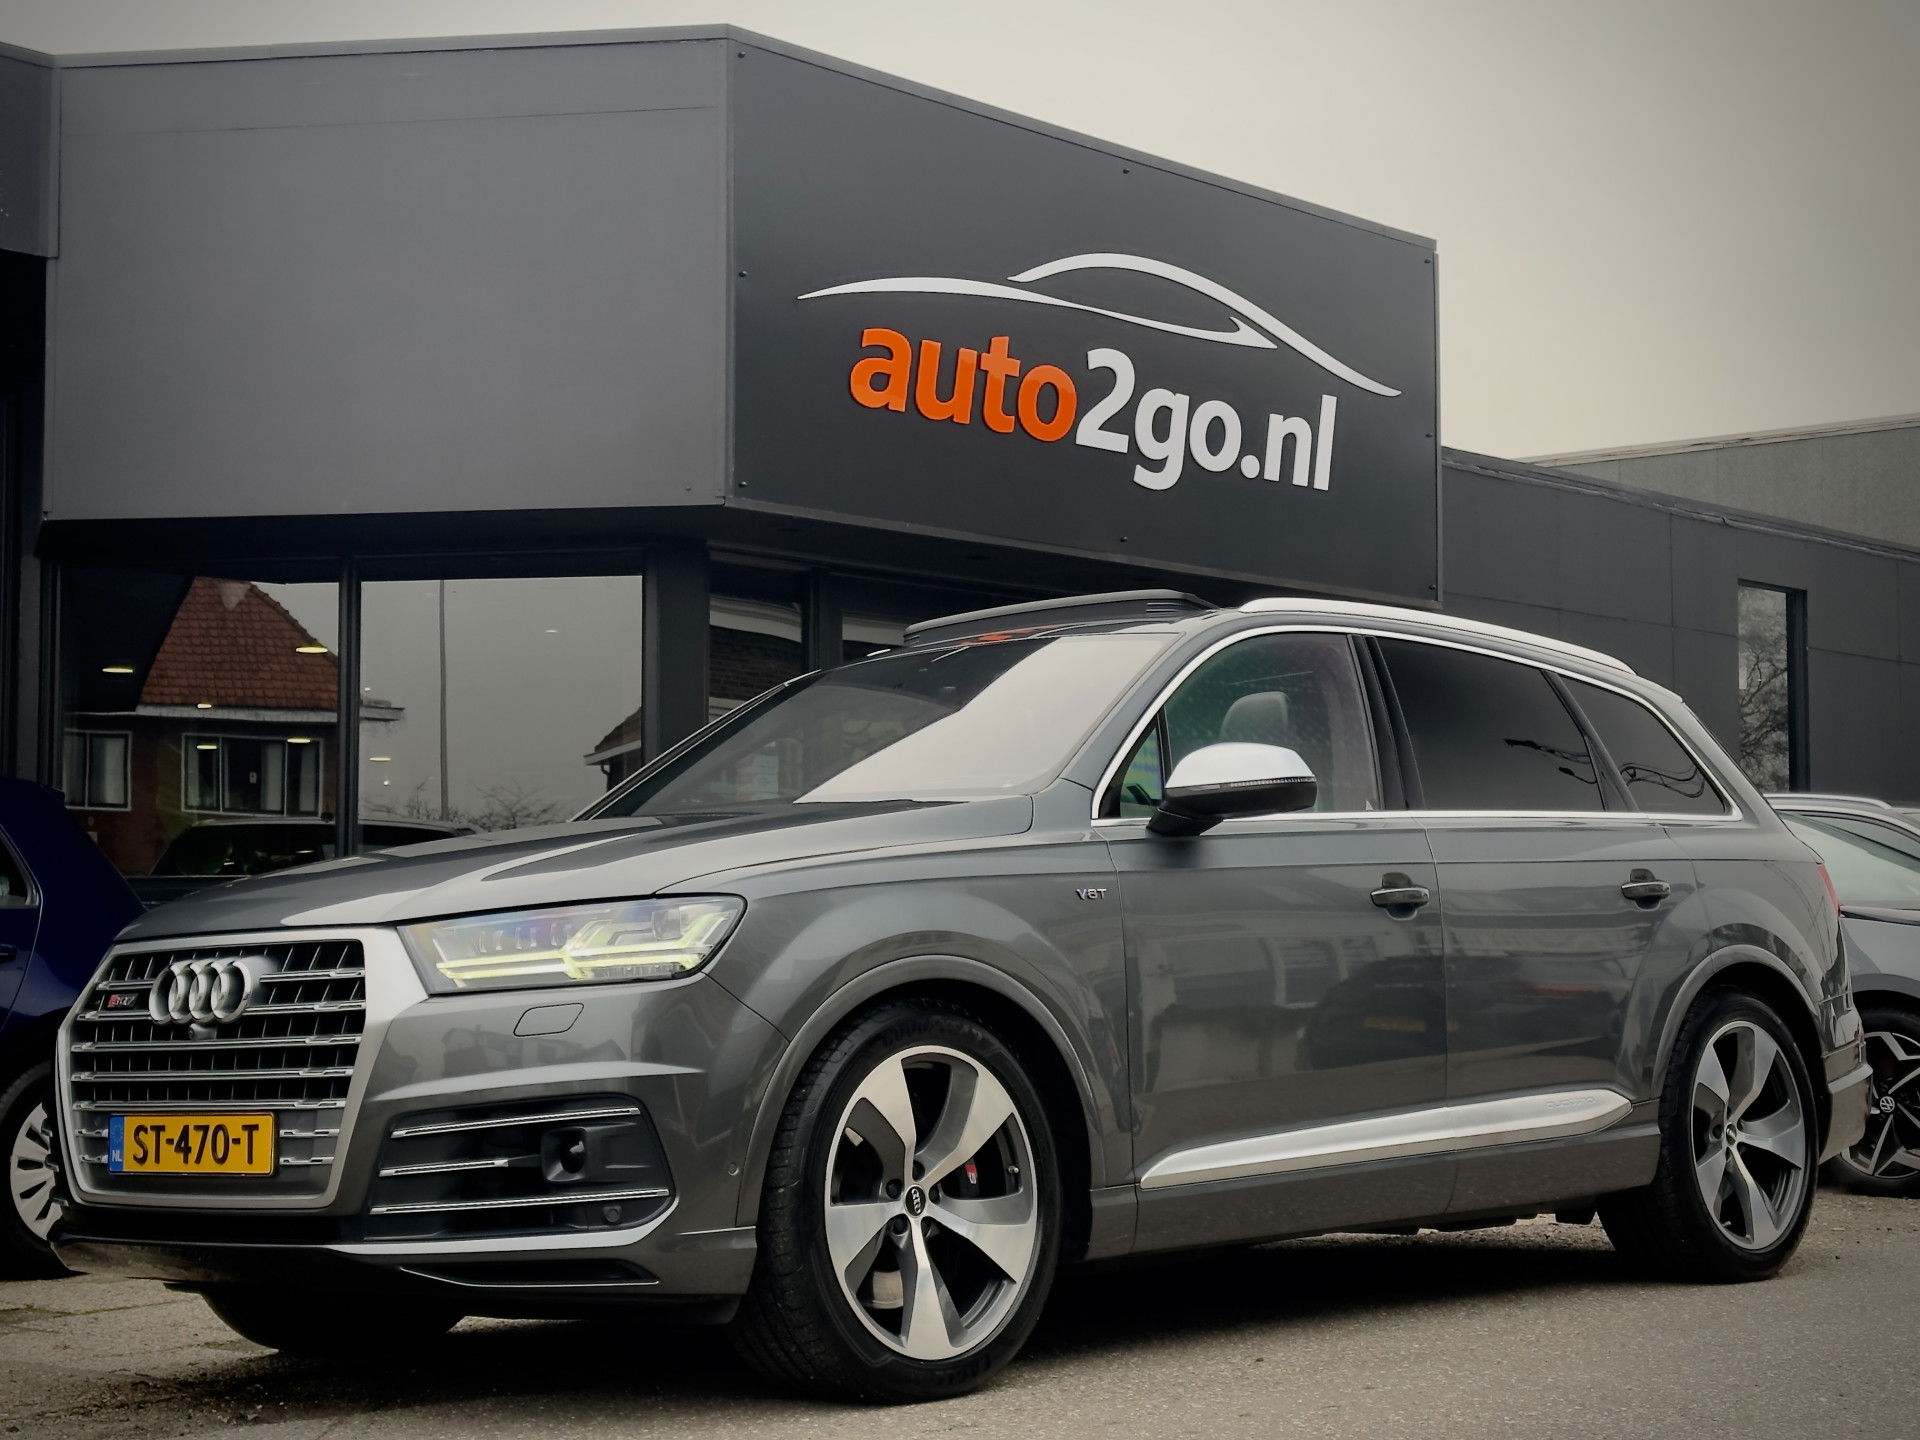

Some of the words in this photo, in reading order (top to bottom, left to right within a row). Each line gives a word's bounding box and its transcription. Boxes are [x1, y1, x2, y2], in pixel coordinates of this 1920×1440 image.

[850, 327, 1338, 491] auto2go.nl
[1075, 888, 1107, 900] V8T
[111, 1150, 123, 1163] NL
[132, 1123, 260, 1166] ST-470-T
